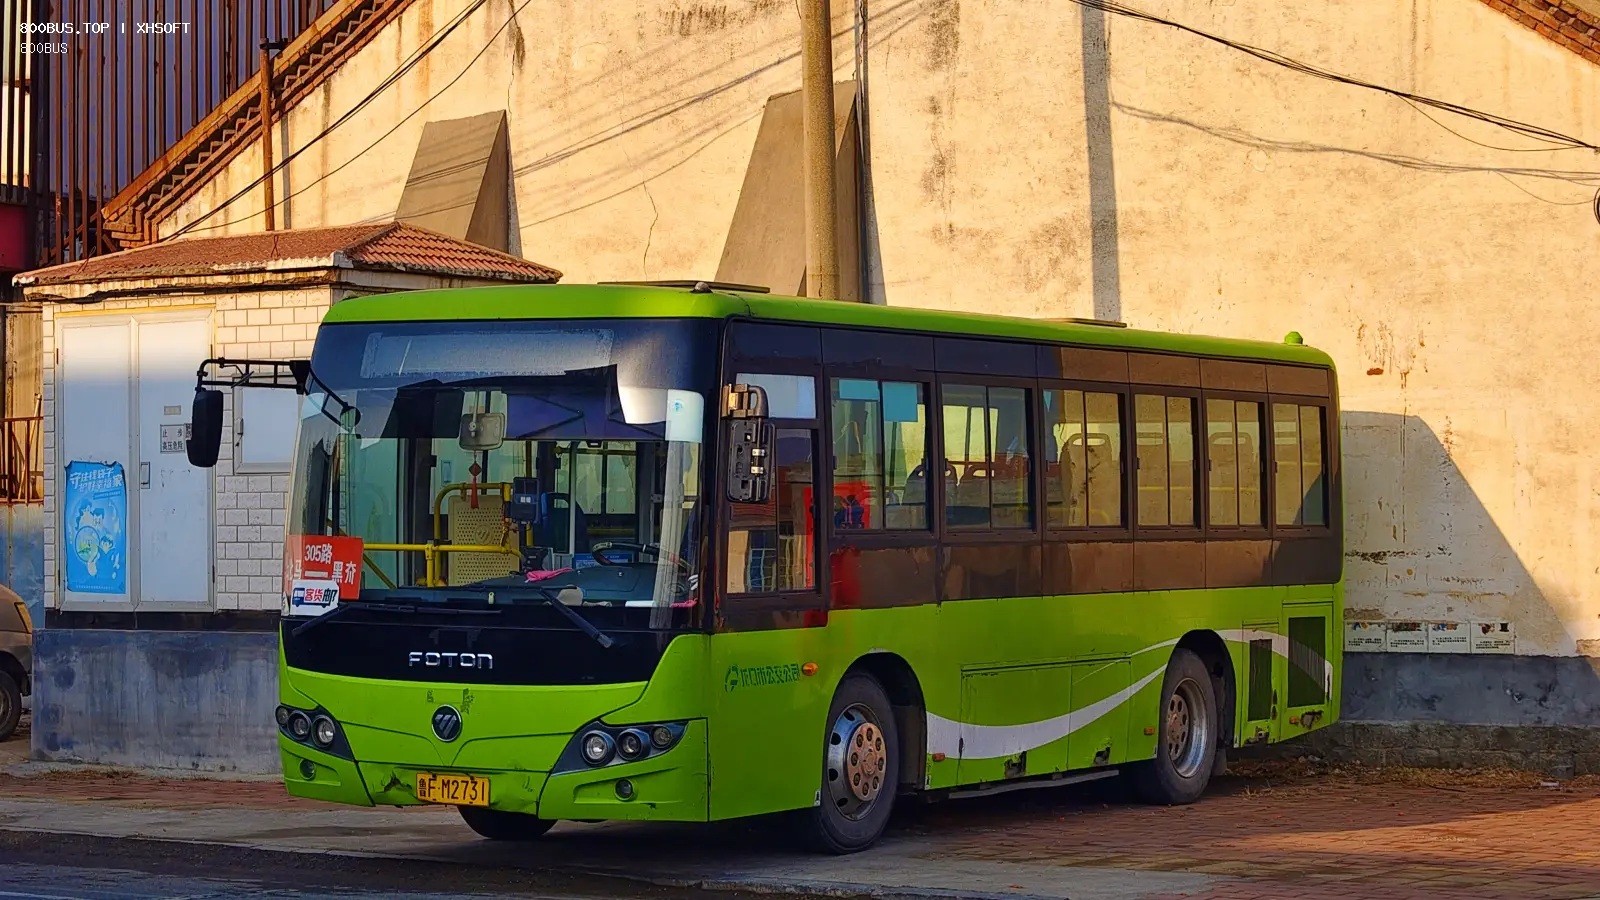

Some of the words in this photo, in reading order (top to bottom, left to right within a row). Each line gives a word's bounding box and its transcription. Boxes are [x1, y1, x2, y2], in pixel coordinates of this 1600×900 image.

[162, 440, 183, 451] 高压危险
[304, 543, 332, 564] 305路
[304, 588, 338, 602] 客货邮
[408, 651, 493, 669] FOTON
